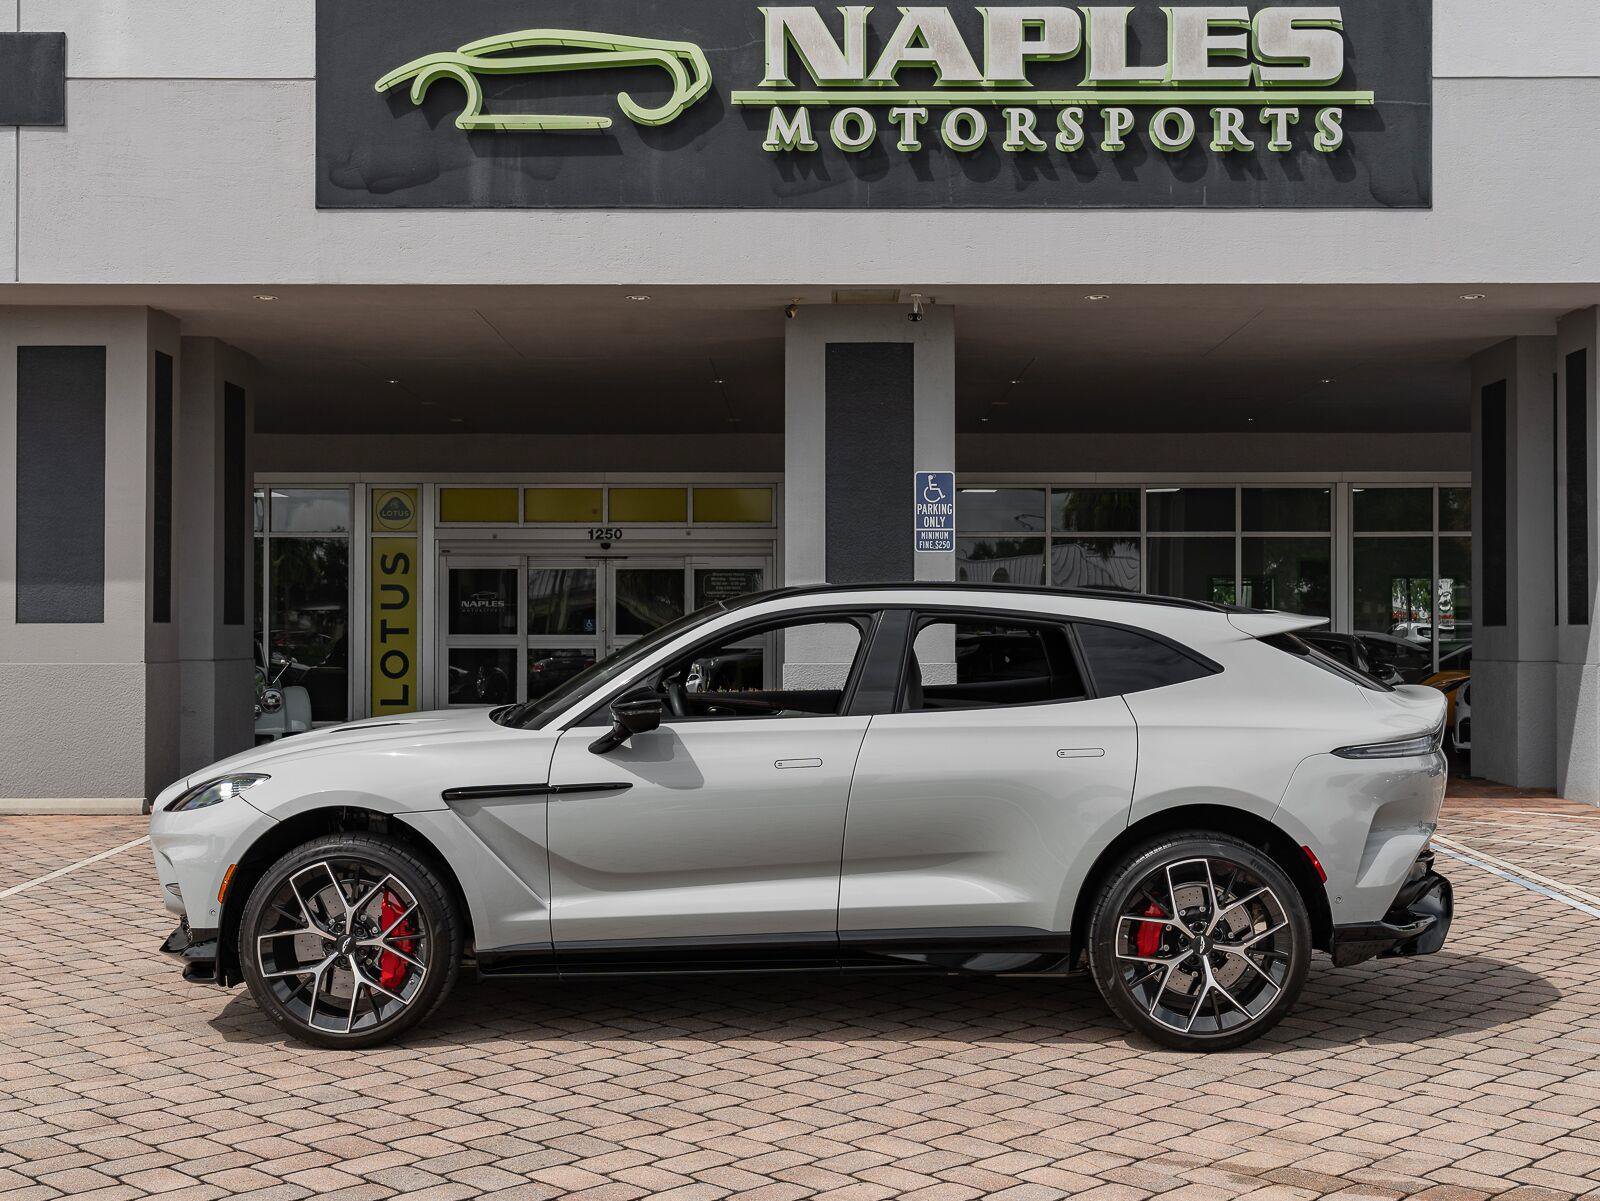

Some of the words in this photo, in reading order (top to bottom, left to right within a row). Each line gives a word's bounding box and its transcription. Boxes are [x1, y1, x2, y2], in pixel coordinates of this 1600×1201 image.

[757, 6, 1344, 87] NAPLES
[762, 106, 1344, 152] MOTORSPORTS
[917, 503, 953, 515] PARKING
[923, 516, 946, 528] ONLY
[587, 528, 623, 540] 1250
[921, 531, 949, 540] MINIMUM
[461, 600, 505, 608] NAPLES
[380, 552, 410, 706] LOTUS
